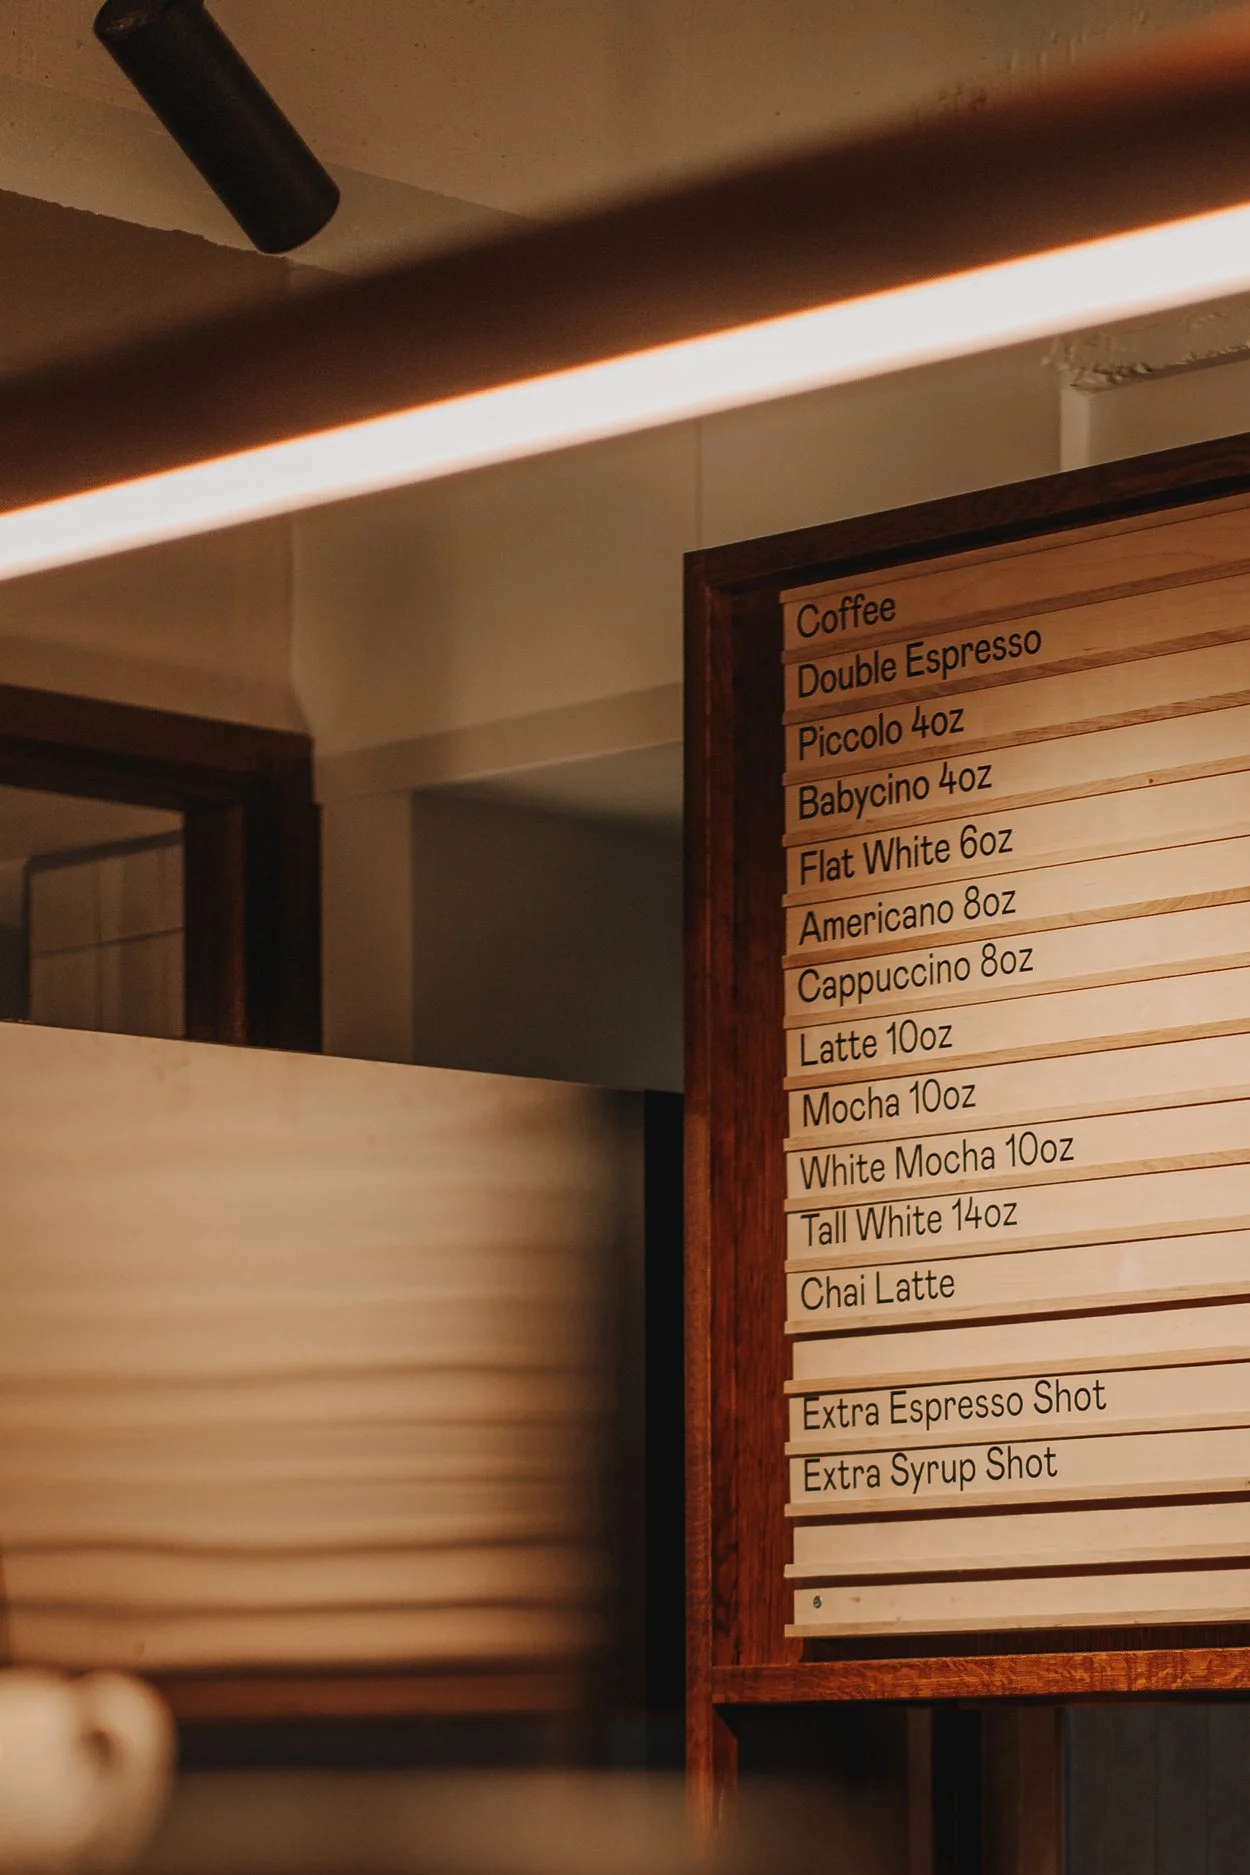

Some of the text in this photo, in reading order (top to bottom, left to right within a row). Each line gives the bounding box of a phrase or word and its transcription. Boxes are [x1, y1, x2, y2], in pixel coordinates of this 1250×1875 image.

[797, 593, 896, 637] Coffee
[798, 650, 896, 698] Double
[906, 629, 1041, 680] Espresso
[799, 712, 901, 760] Piccolo
[911, 707, 964, 739] 4oz
[800, 773, 929, 820] Babycino
[939, 762, 992, 795] 4oz
[801, 847, 855, 885] Flat
[863, 833, 950, 875] White
[960, 824, 1013, 859] 6oz
[799, 897, 953, 945] Americano
[964, 886, 1016, 918] 8oz
[797, 953, 970, 1006] Cappuccino
[981, 943, 1033, 977] 8oz
[800, 1031, 877, 1066] Latte
[886, 1019, 953, 1055] 10oz
[803, 1086, 900, 1128] Mocha
[909, 1079, 976, 1112] 10oz
[800, 1154, 885, 1190] White
[896, 1138, 995, 1180] Mocha
[1005, 1131, 1074, 1167] 10oz
[801, 1210, 846, 1247] Tall
[856, 1204, 942, 1241] White
[951, 1197, 1018, 1231] 14oz
[801, 1275, 865, 1311] Chai
[876, 1270, 955, 1304] Latte
[803, 1396, 879, 1430] Extra
[890, 1389, 1023, 1431] Espresso
[1033, 1379, 1107, 1413] Shot
[804, 1458, 880, 1492] Extra
[891, 1452, 976, 1494] Syrup
[986, 1445, 1058, 1481] Shot
